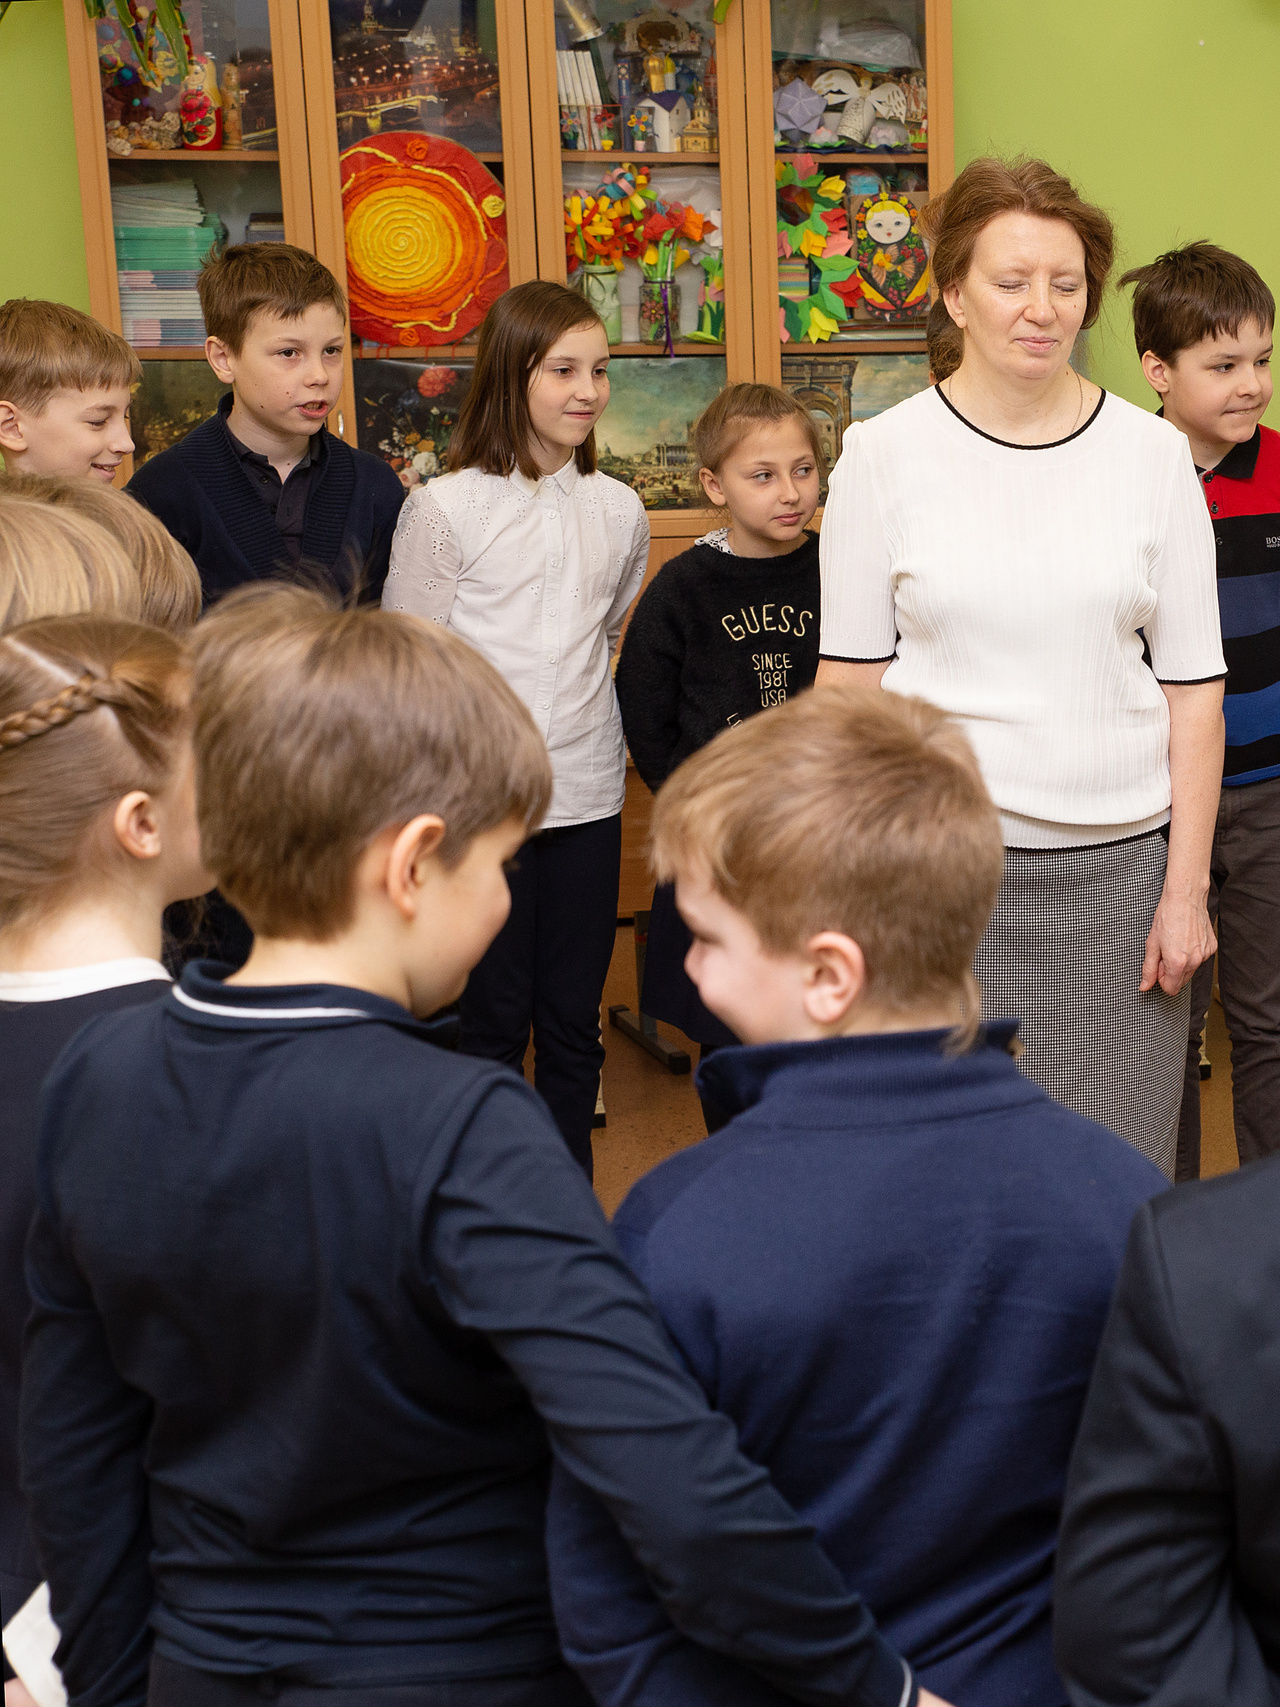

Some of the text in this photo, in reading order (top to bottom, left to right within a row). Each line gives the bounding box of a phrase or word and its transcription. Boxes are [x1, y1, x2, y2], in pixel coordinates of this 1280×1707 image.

[721, 603, 813, 642] GUESS
[751, 653, 793, 671] SINCE
[757, 670, 788, 690] 1981
[760, 688, 787, 708] USA
